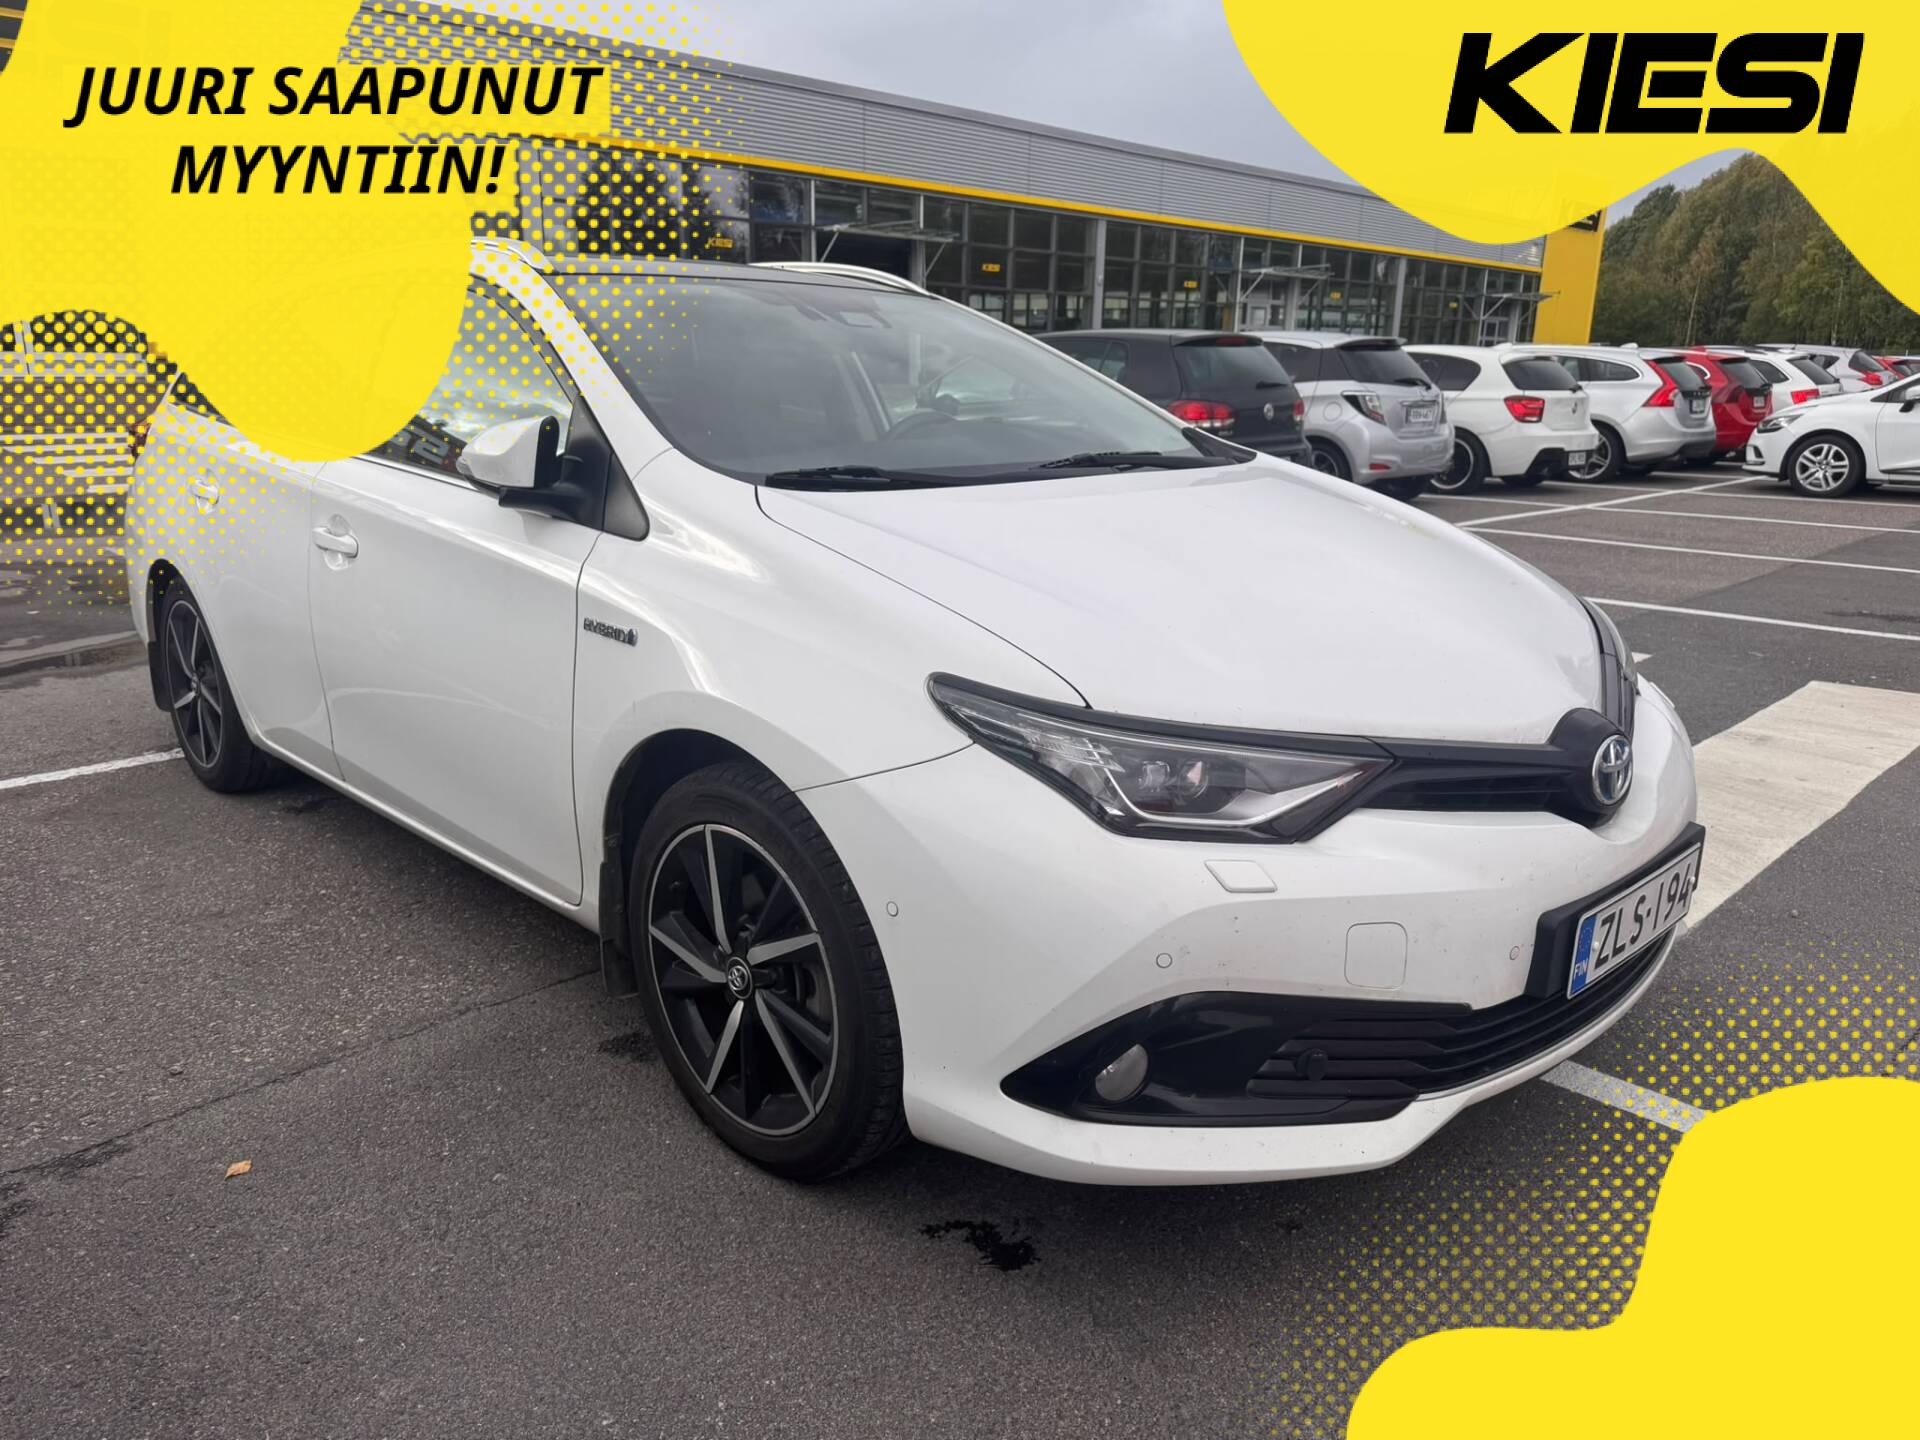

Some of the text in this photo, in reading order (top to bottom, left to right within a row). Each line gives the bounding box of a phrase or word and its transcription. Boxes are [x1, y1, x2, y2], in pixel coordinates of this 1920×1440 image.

[583, 617, 627, 644] HYBRID
[1594, 863, 1692, 970] ZLS-194
[1574, 958, 1588, 977] FIN
